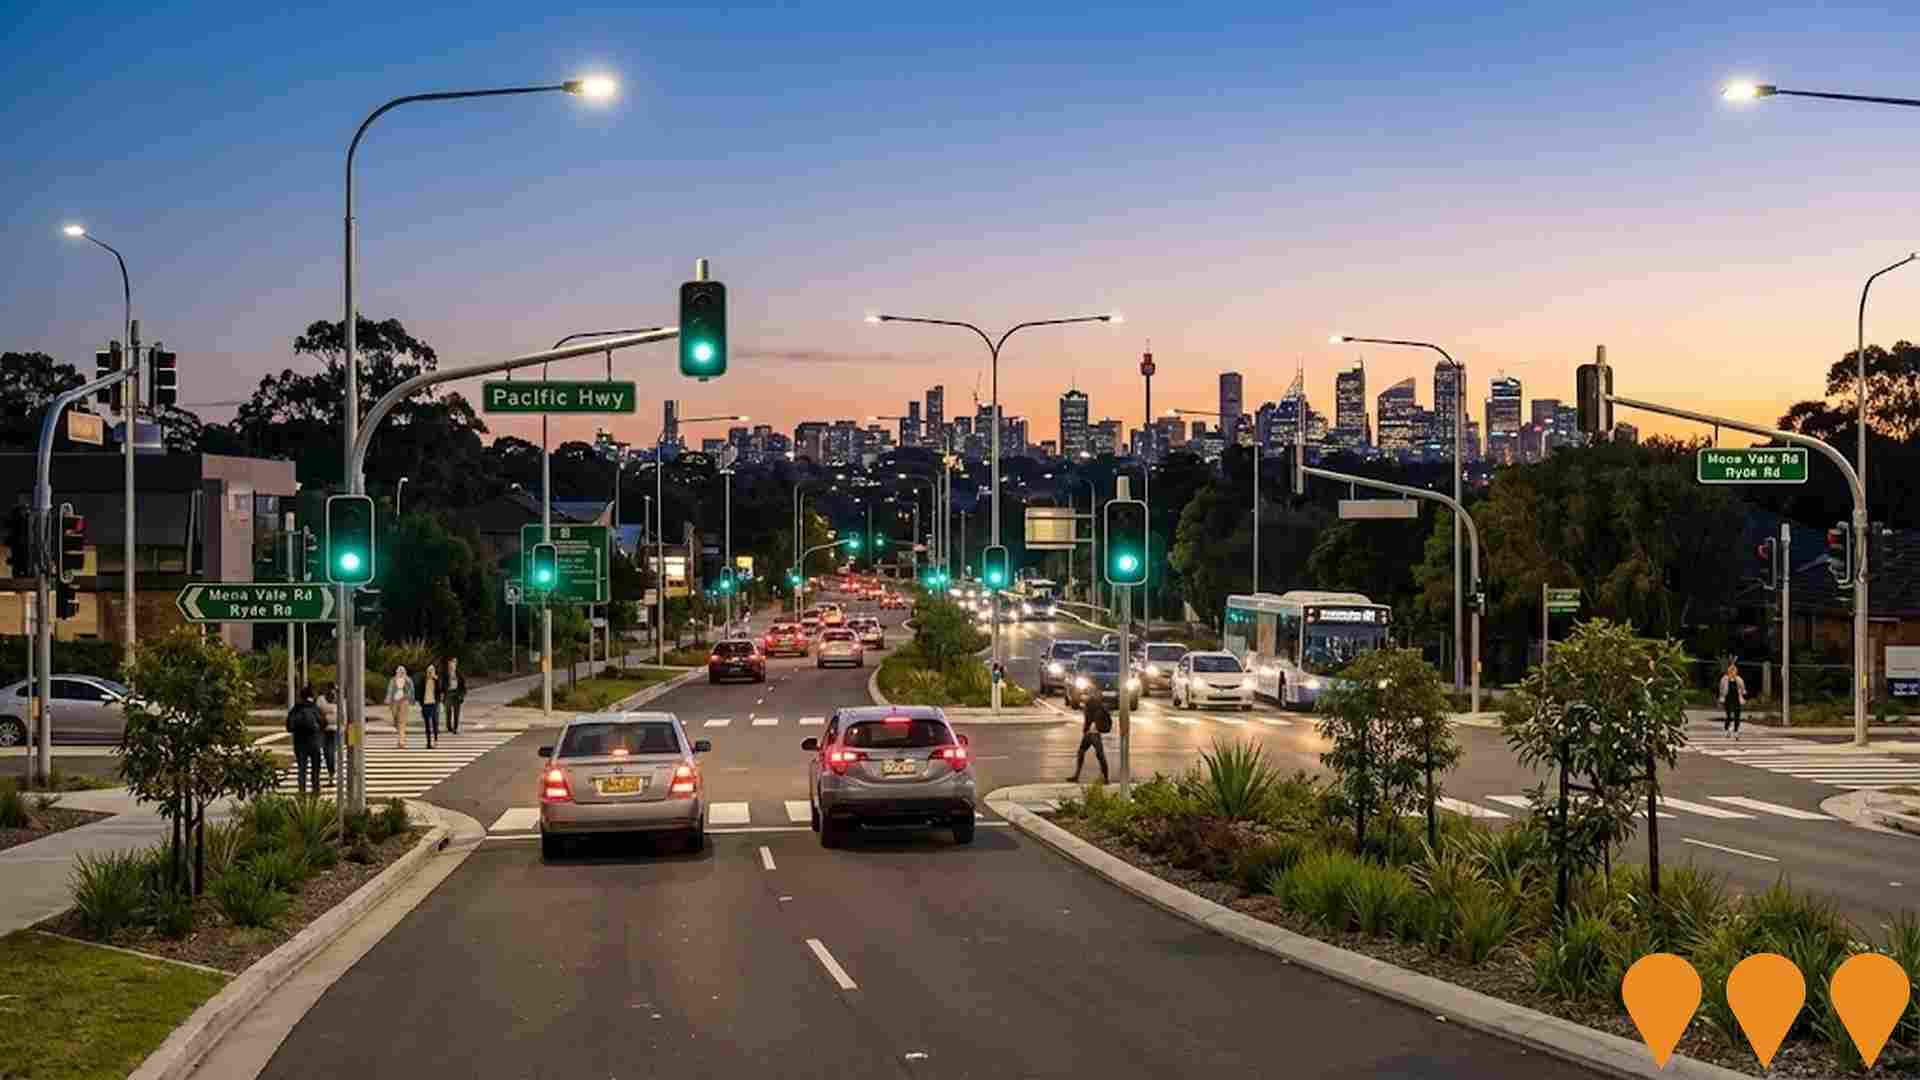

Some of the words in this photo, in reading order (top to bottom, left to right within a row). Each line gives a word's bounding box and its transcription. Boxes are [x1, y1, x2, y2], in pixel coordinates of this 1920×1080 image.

[578, 388, 624, 410] Hwy
[293, 588, 313, 601] Rd
[229, 603, 267, 618] Ryde
